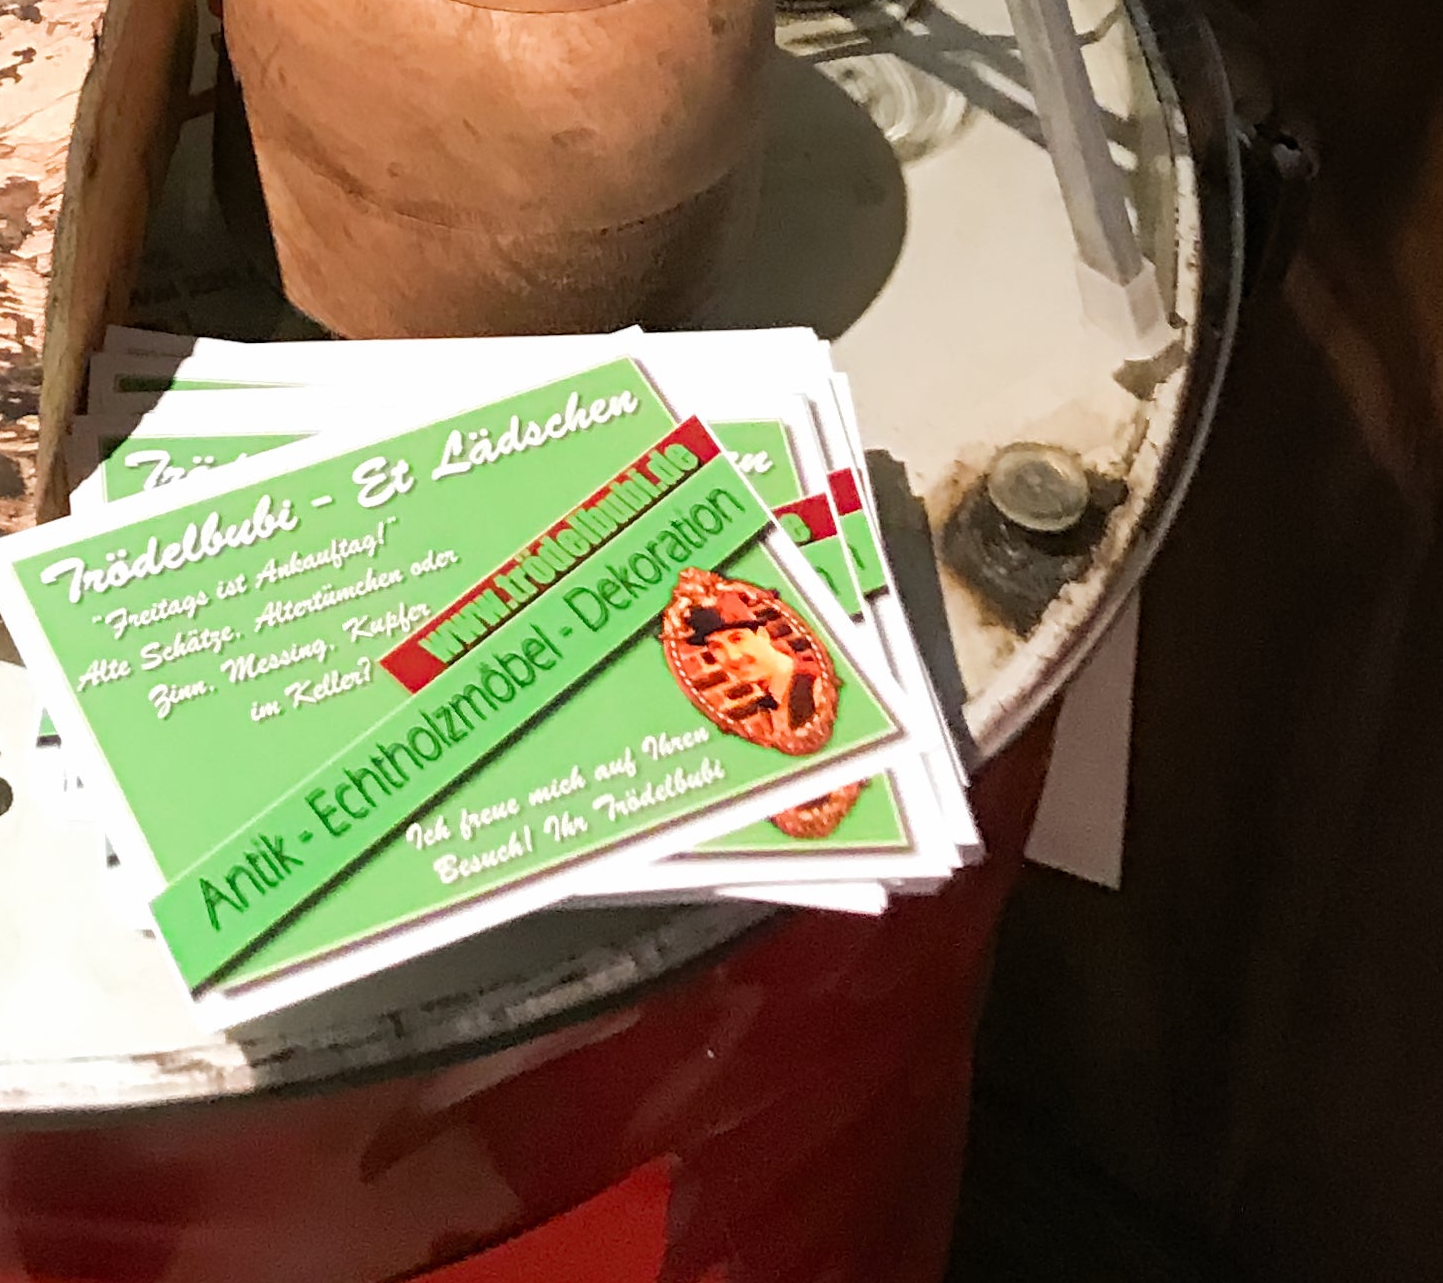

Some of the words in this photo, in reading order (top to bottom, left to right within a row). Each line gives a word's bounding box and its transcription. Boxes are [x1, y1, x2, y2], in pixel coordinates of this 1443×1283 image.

[40, 495, 300, 605] Trödelbubi
[352, 456, 416, 509] Et
[430, 389, 640, 482] Lädschen
[417, 439, 699, 666] www.trödelbubi.de
[77, 656, 131, 692] Alte
[254, 566, 404, 633] Altertümchen
[410, 547, 460, 575] oder
[216, 572, 248, 600] ist
[342, 600, 432, 643] Kupfer
[198, 833, 304, 932] Antik
[305, 623, 563, 838] Echtholzmöbel
[563, 486, 746, 633] Dekoration
[250, 700, 281, 722] im
[285, 656, 375, 709] Keller?
[405, 820, 452, 851] Ich
[459, 795, 521, 841] freue
[527, 767, 587, 805] mich
[594, 749, 637, 786] auf
[641, 727, 710, 762] Ihren
[434, 828, 535, 885] Besuch!
[544, 812, 588, 842] Ihr
[592, 759, 726, 824] Trödelbubi
